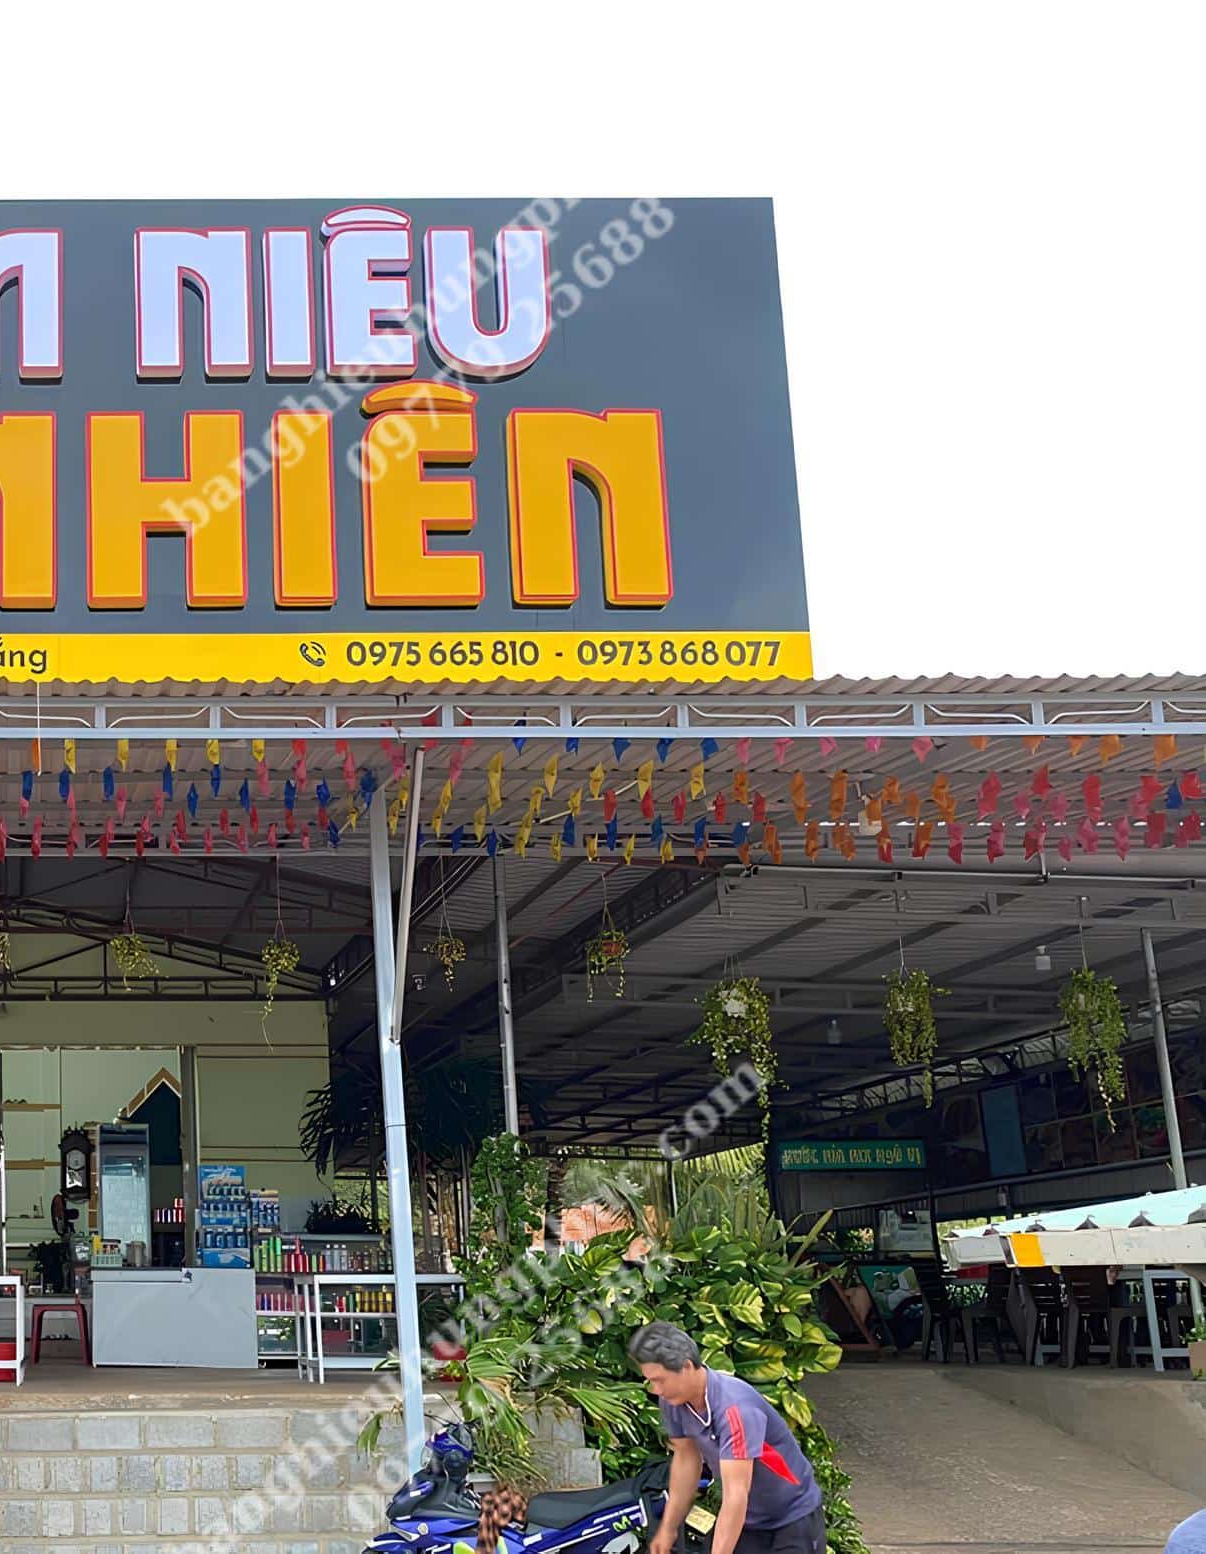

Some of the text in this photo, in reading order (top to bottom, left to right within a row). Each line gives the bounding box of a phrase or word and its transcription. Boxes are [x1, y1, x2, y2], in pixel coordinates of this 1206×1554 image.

[134, 205, 551, 378] NIÊU
[346, 641, 420, 666] 0975
[429, 641, 483, 666] 665
[491, 641, 540, 666] 810
[577, 641, 652, 666] 0973
[659, 641, 718, 666] 868
[725, 641, 781, 666] 077
